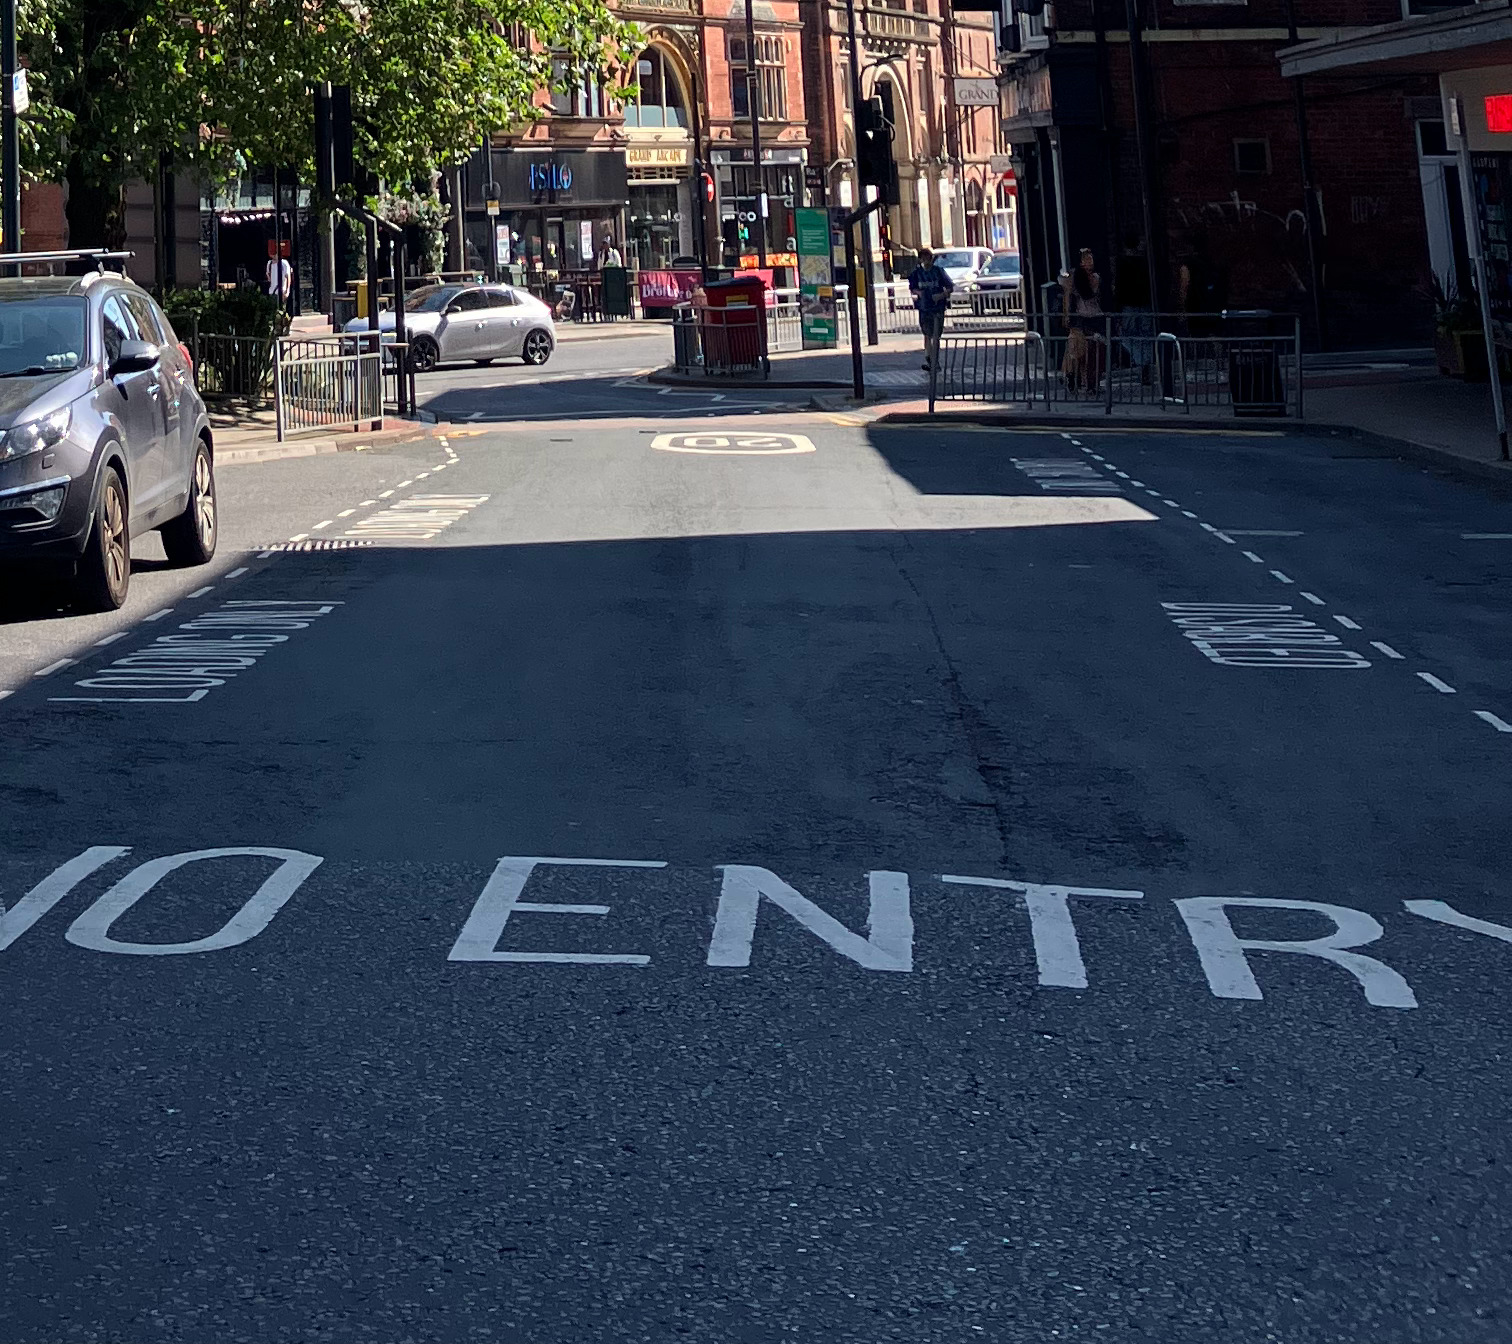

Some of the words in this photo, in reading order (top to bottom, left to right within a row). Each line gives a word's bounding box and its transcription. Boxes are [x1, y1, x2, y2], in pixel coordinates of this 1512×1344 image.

[47, 633, 289, 702] LOADING
[178, 600, 346, 630] ONLY
[1160, 602, 1372, 669] DISABLED
